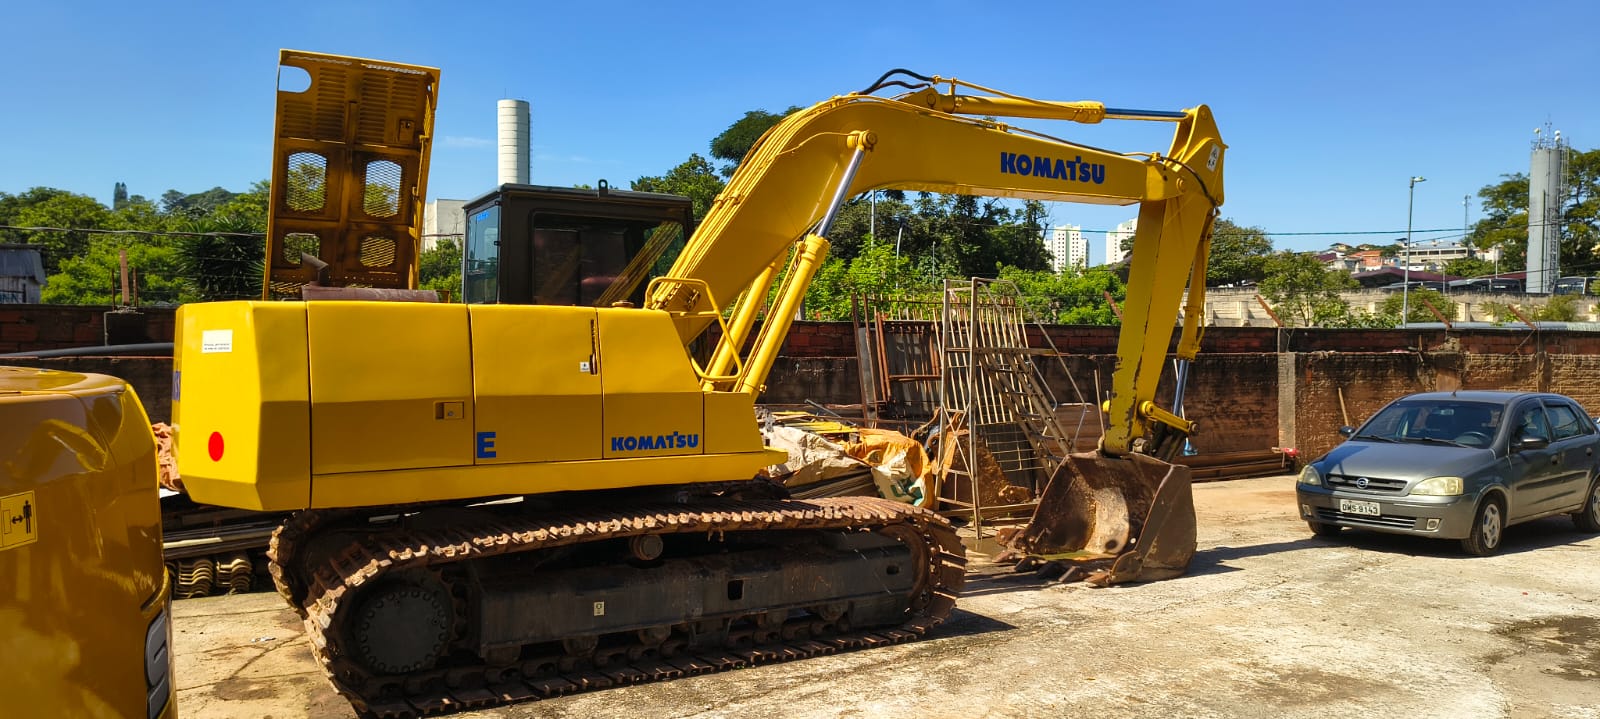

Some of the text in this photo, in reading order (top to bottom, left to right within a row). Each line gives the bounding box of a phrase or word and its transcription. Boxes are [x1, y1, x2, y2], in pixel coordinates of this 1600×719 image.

[1000, 151, 1105, 185] KOMATSU
[477, 431, 496, 458] E
[611, 431, 699, 451] KOMATSU
